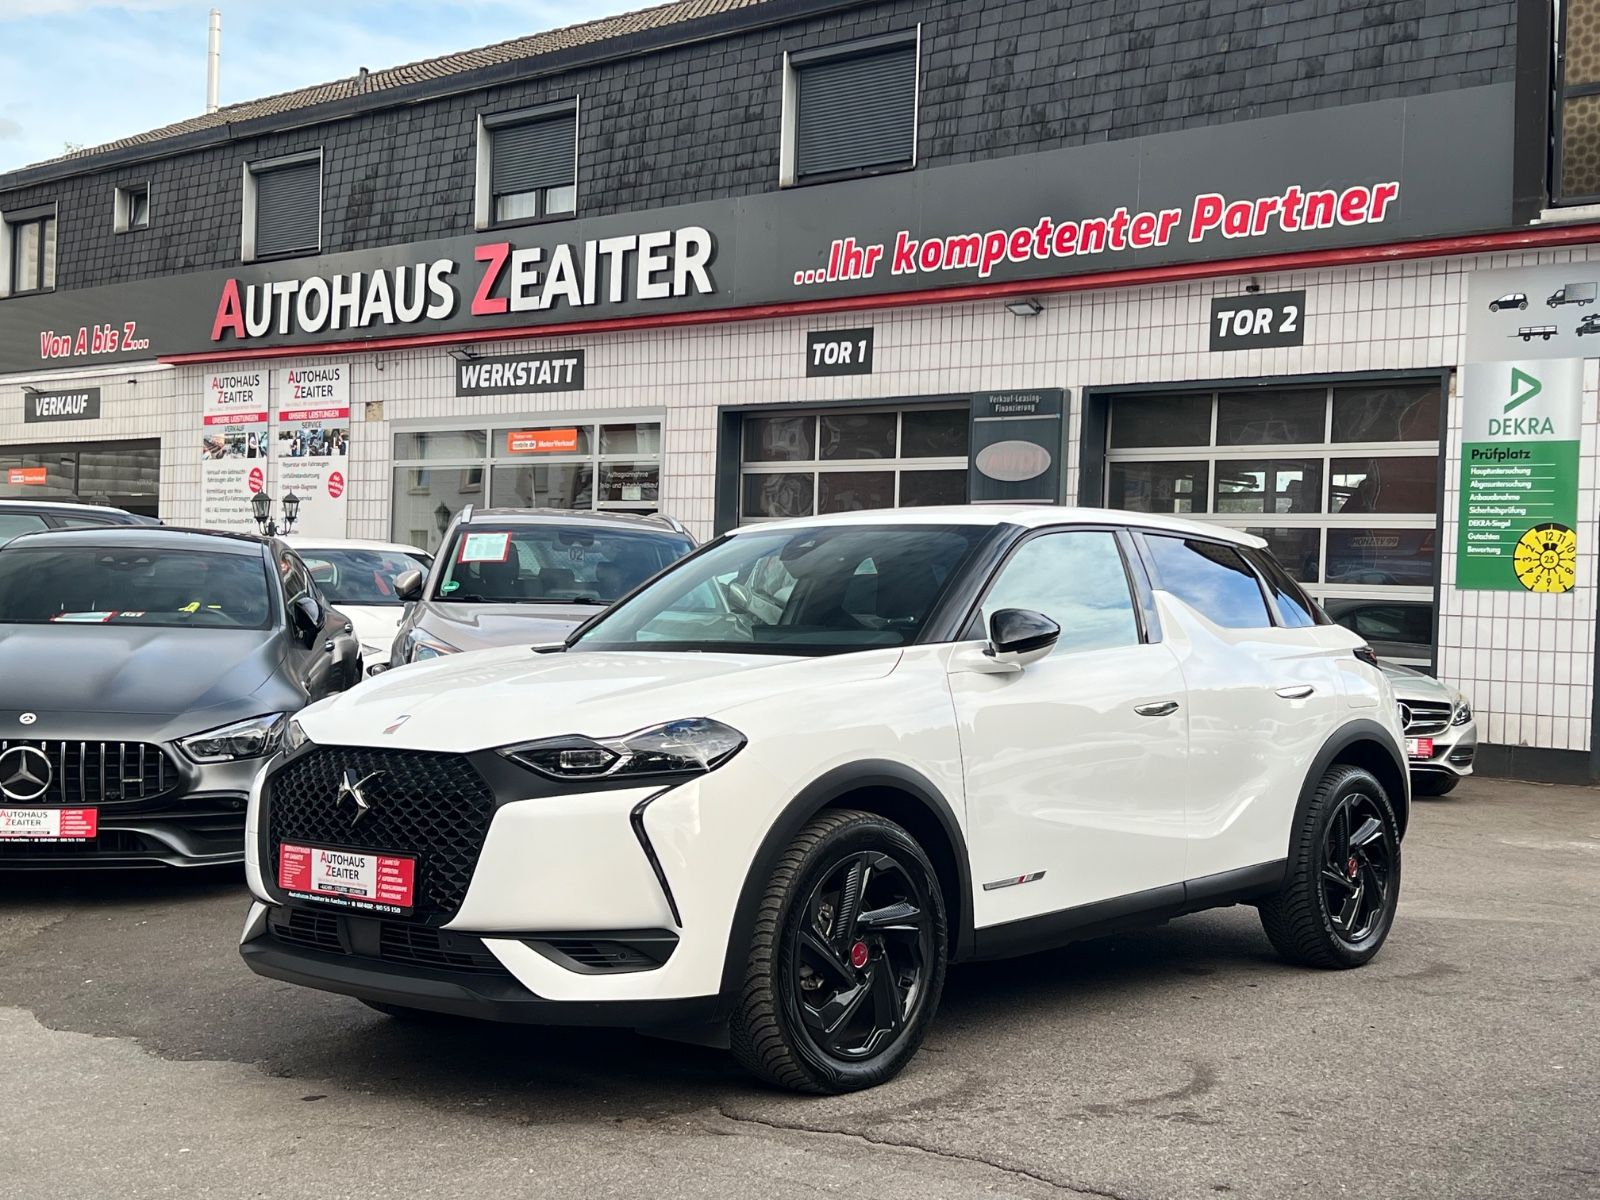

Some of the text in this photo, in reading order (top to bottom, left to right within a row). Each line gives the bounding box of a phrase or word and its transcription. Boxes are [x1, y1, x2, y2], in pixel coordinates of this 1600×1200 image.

[890, 207, 1182, 278] kompetenter
[1188, 181, 1400, 242] Partner
[211, 226, 713, 341] AUTOHAUS ZEAITER
[1217, 305, 1298, 337] TOR 2
[40, 321, 149, 359] Von A bis Z...
[812, 339, 867, 366] TOR 1
[288, 368, 340, 384] AUTOHAUS
[461, 358, 578, 389] WERKSTATT
[212, 374, 260, 390] AUTOHAUS
[217, 390, 254, 404] ZEAITER
[294, 385, 333, 399] ZEAITER
[35, 394, 88, 416] VERKAUF
[995, 404, 1035, 413] Finanzierung
[1488, 416, 1555, 436] DEKRA
[1471, 447, 1531, 462] Prüfplatz
[1470, 466, 1531, 476] Hauptuntersuchung
[1470, 480, 1532, 489] Abgasuntersuchung
[1469, 493, 1520, 501] Anbauabnahme
[1468, 506, 1527, 515] Sicherheitsprüfung
[1468, 519, 1511, 528] DEKRA-Siegel
[1545, 531, 1554, 540] 12
[1557, 533, 1566, 544] 11
[1467, 546, 1501, 555] Bewertung
[1565, 542, 1576, 554] 10
[320, 851, 365, 868] AUTOHAUS
[325, 865, 359, 880] ZEAITER
